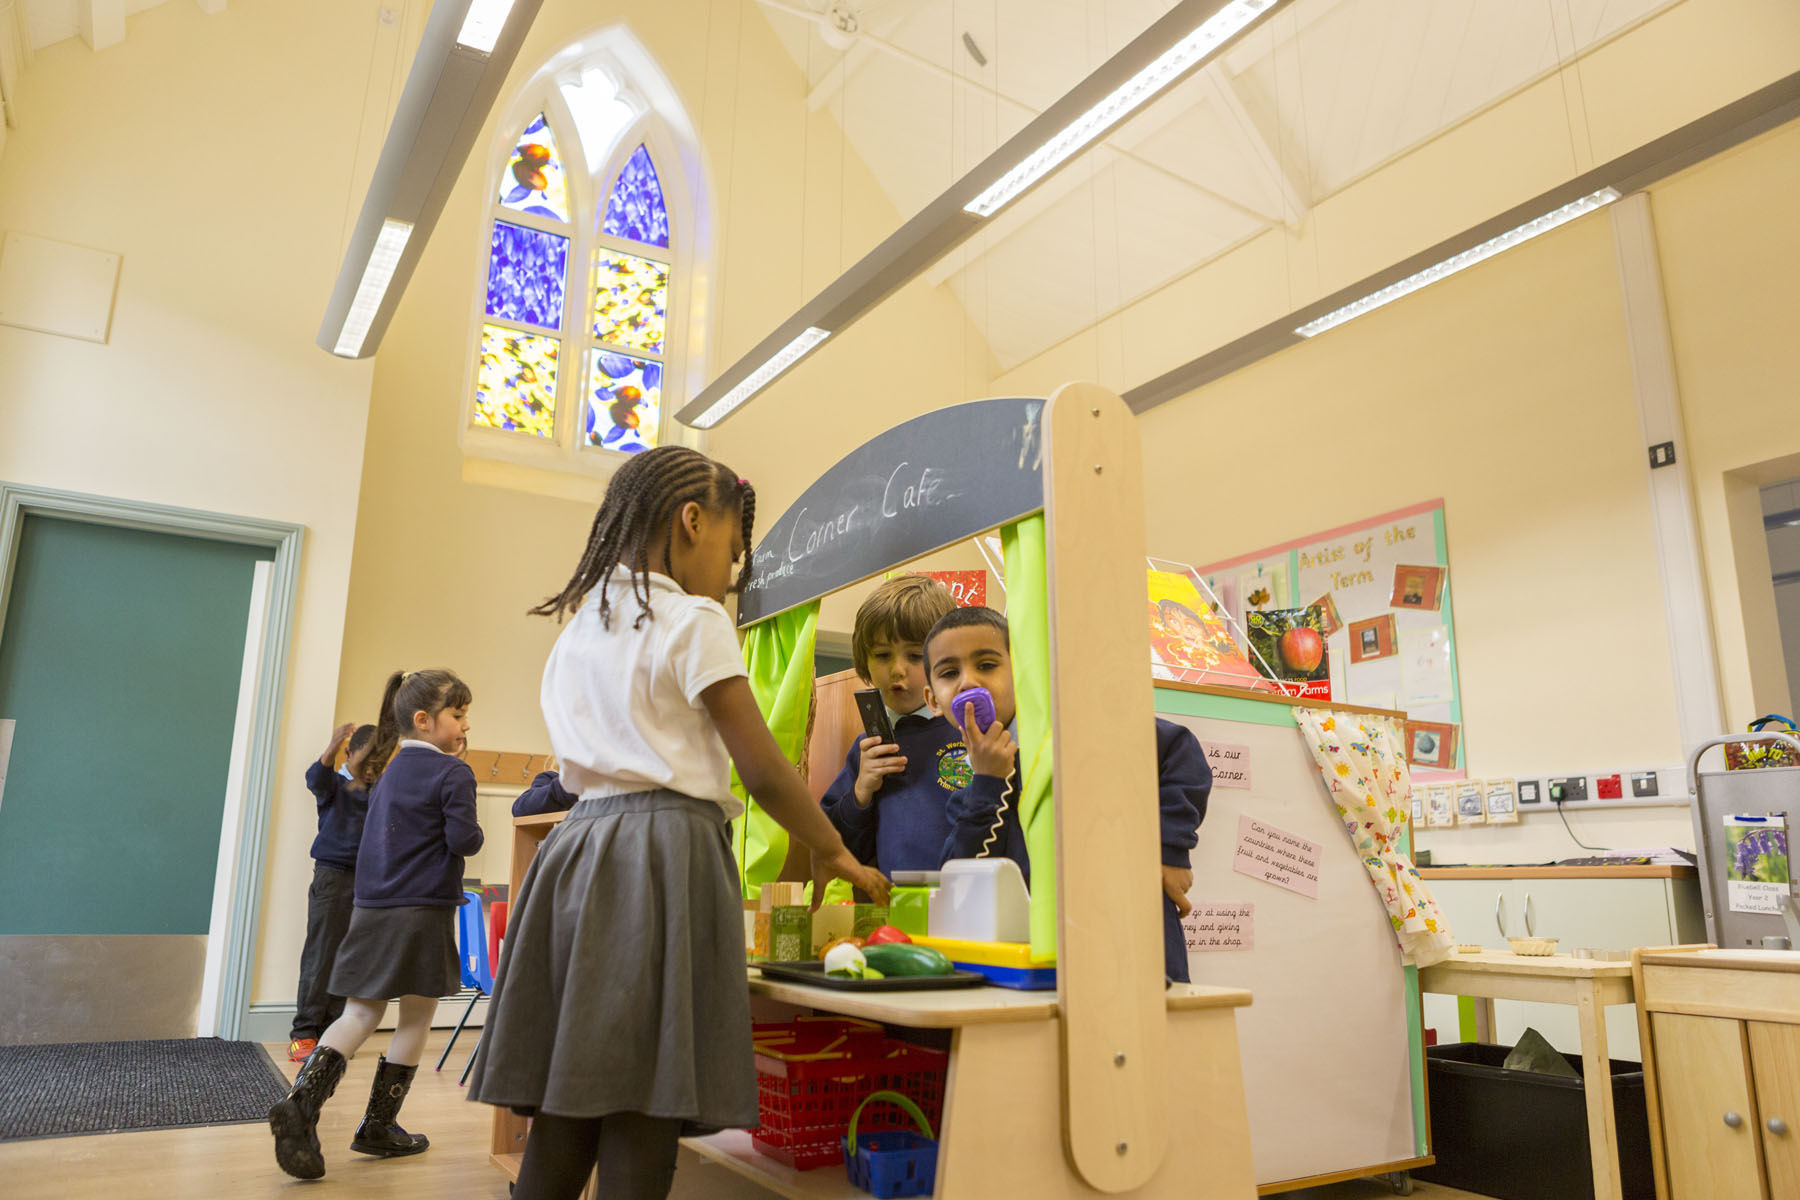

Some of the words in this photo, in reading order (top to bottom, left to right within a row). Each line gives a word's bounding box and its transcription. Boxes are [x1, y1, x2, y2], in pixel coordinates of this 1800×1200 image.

[788, 505, 859, 563] Corner
[1298, 546, 1345, 572] Artist
[1353, 537, 1374, 563] of
[1384, 525, 1416, 545] the
[1330, 571, 1375, 591] Term
[1208, 747, 1220, 758] is
[1223, 751, 1241, 760] our
[1211, 766, 1247, 780] Corner.
[1251, 822, 1265, 834] Can
[1267, 831, 1281, 840] you
[1282, 838, 1301, 848] name
[1302, 842, 1312, 852] the
[1243, 836, 1275, 852] countries
[1276, 847, 1297, 860] where
[1236, 845, 1254, 858] fruit
[1255, 853, 1269, 864] and
[1270, 860, 1305, 877] vegetables
[1192, 909, 1202, 919] go
[1205, 907, 1214, 916] at
[1216, 907, 1237, 919] using
[1239, 907, 1250, 917] the
[1184, 924, 1197, 934] ney
[1199, 923, 1215, 931] and
[1217, 923, 1240, 934] giving
[1209, 937, 1220, 946] the
[1223, 936, 1242, 947] shop
